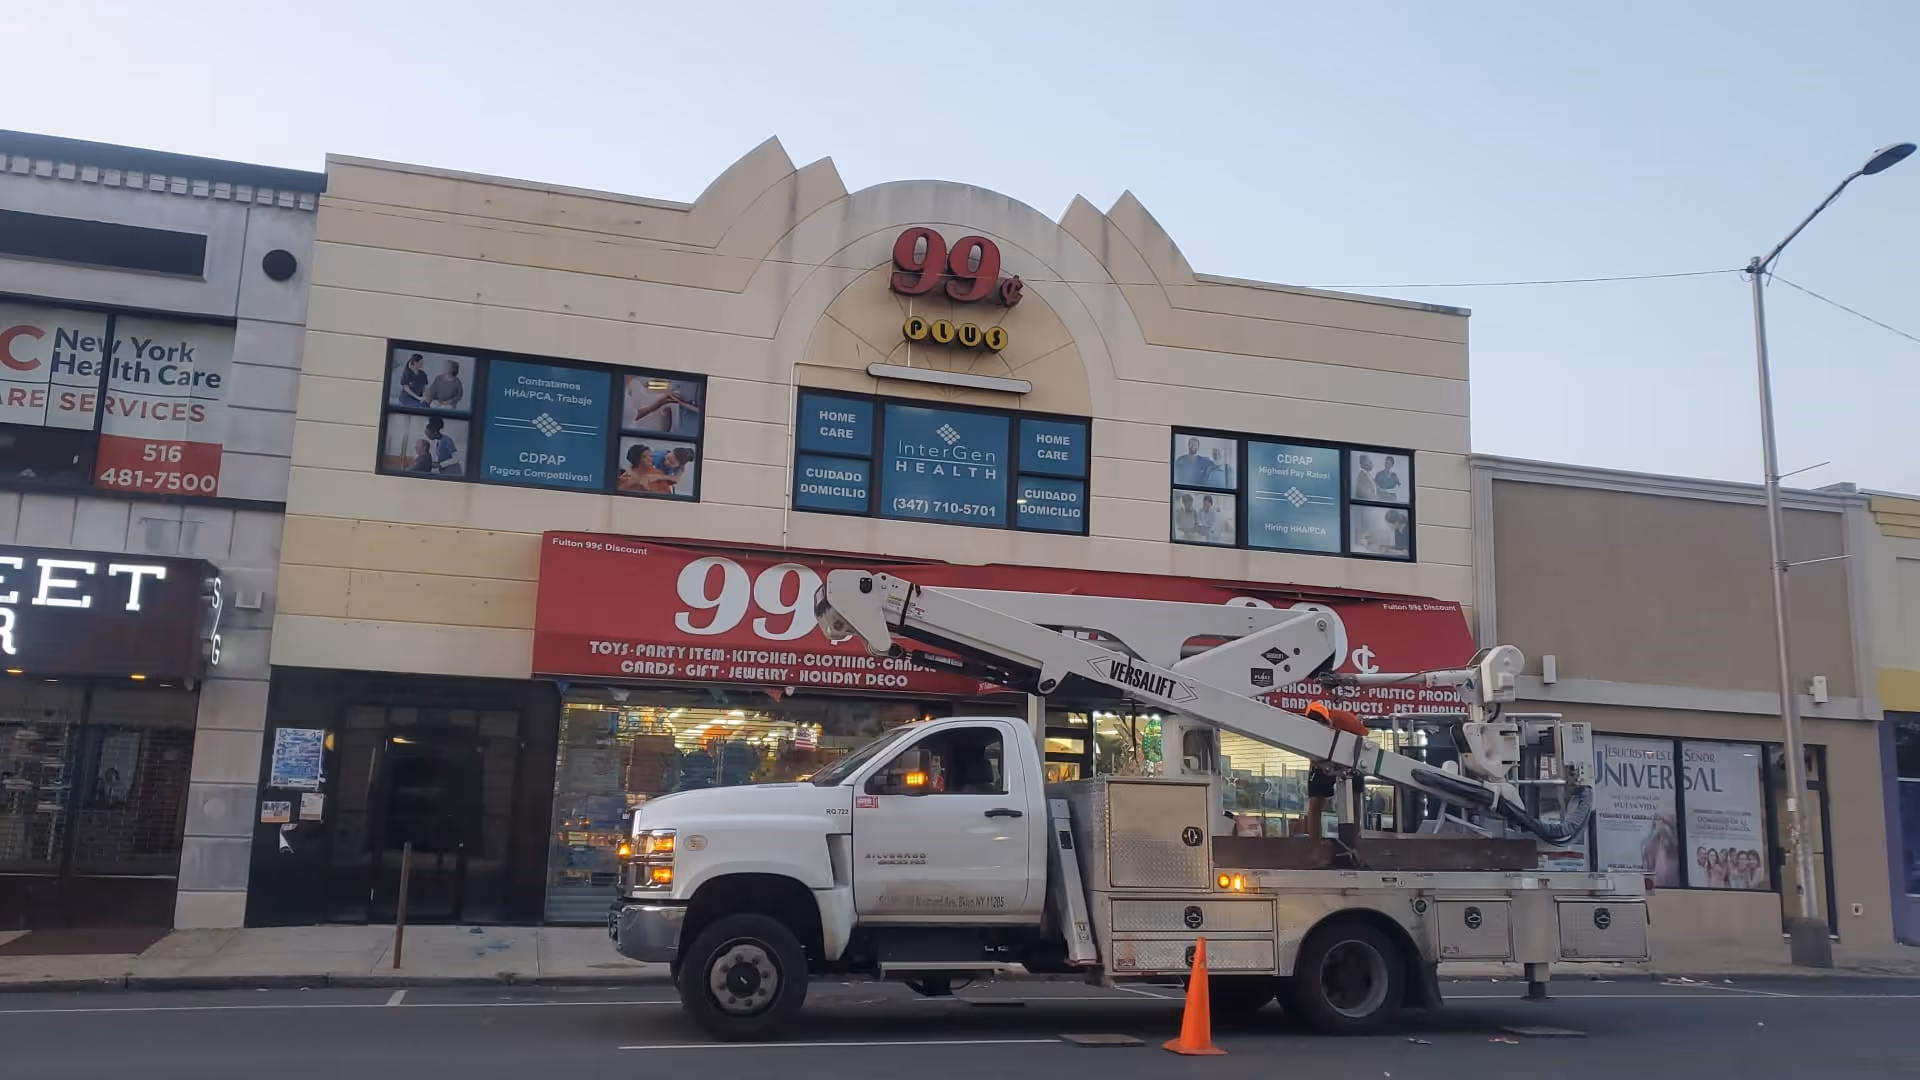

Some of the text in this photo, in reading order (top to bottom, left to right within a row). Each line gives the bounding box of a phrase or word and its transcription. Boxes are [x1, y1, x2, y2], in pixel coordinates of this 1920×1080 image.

[909, 319, 1003, 348] PLUS
[55, 327, 195, 363] New York
[52, 352, 221, 389] Health Care
[518, 376, 581, 391] Contratamos
[504, 388, 554, 402] HHA/PCA,
[0, 386, 206, 423] RE SERVICES
[819, 410, 856, 424] HOME
[820, 426, 854, 439] CARE
[1036, 433, 1071, 446] HOME
[143, 444, 182, 463] 516
[519, 452, 566, 466] CDPAP
[898, 440, 996, 464] InterGen
[1037, 449, 1069, 461] CARE
[1277, 454, 1313, 466] CDPAP
[489, 465, 521, 477] Pagos
[805, 468, 863, 483] CUIDADO
[896, 460, 997, 480] HEALTH
[1290, 469, 1305, 479] Pay
[100, 467, 216, 493] 481-7500
[800, 483, 866, 499] DOMICILIO
[1024, 488, 1077, 502] CUIDADO
[893, 497, 996, 518] (347) 710-5701
[1020, 503, 1081, 519] DOMICILIO
[1264, 523, 1289, 534] Hiring
[552, 537, 583, 549] Fulton
[605, 543, 648, 555] Discount
[1423, 604, 1457, 612] Discount
[589, 641, 629, 656] TOYS
[636, 644, 686, 659] PARTY
[689, 648, 725, 661] ITEM
[732, 650, 797, 665] KITCHEN
[804, 654, 876, 669] CLOTHING
[621, 660, 908, 687] CARDS GIFT JEWELRY HOLIDAY DECO
[1110, 659, 1177, 699] VERSALIFT
[1368, 687, 1415, 700] PLASTIC
[1418, 690, 1464, 703] PRODU
[1595, 751, 1723, 793] UNIVERSAL
